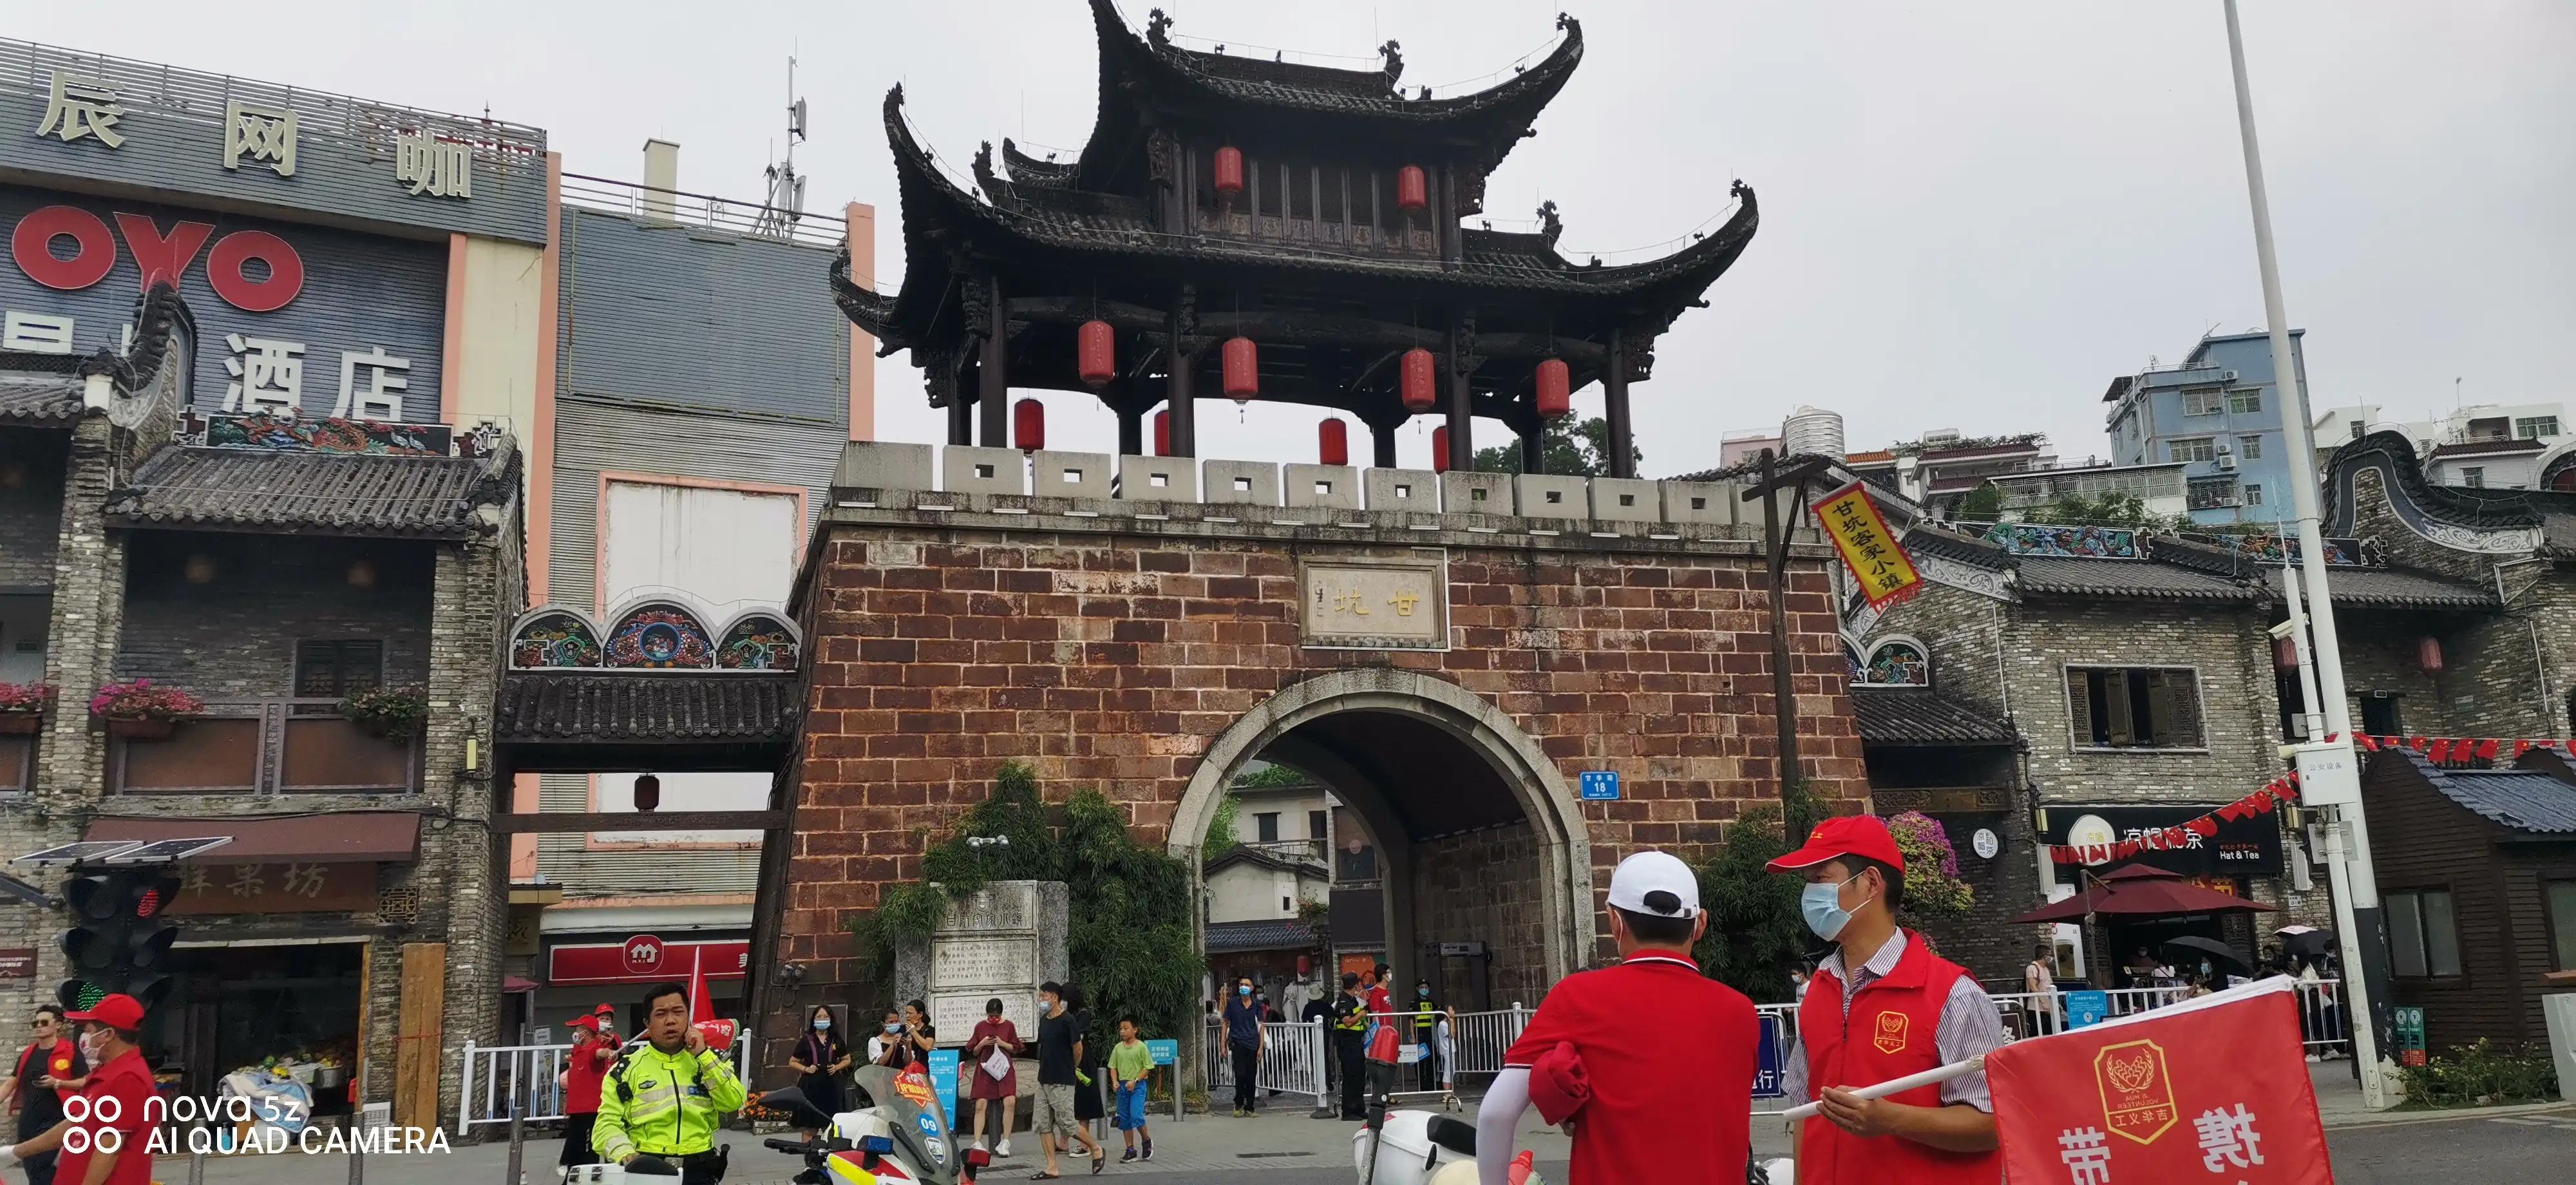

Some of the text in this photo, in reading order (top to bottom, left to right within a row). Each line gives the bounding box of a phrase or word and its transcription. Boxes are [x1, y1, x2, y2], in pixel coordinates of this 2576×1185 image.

[36, 71, 472, 198] 辰网咖
[12, 205, 303, 312] OYO
[2309, 763, 2342, 771] 公安设备
[1595, 782, 1605, 792] 18
[2220, 851, 2260, 859] Hat & Tea
[1751, 1069, 1774, 1090] 行
[920, 1117, 937, 1132] 09
